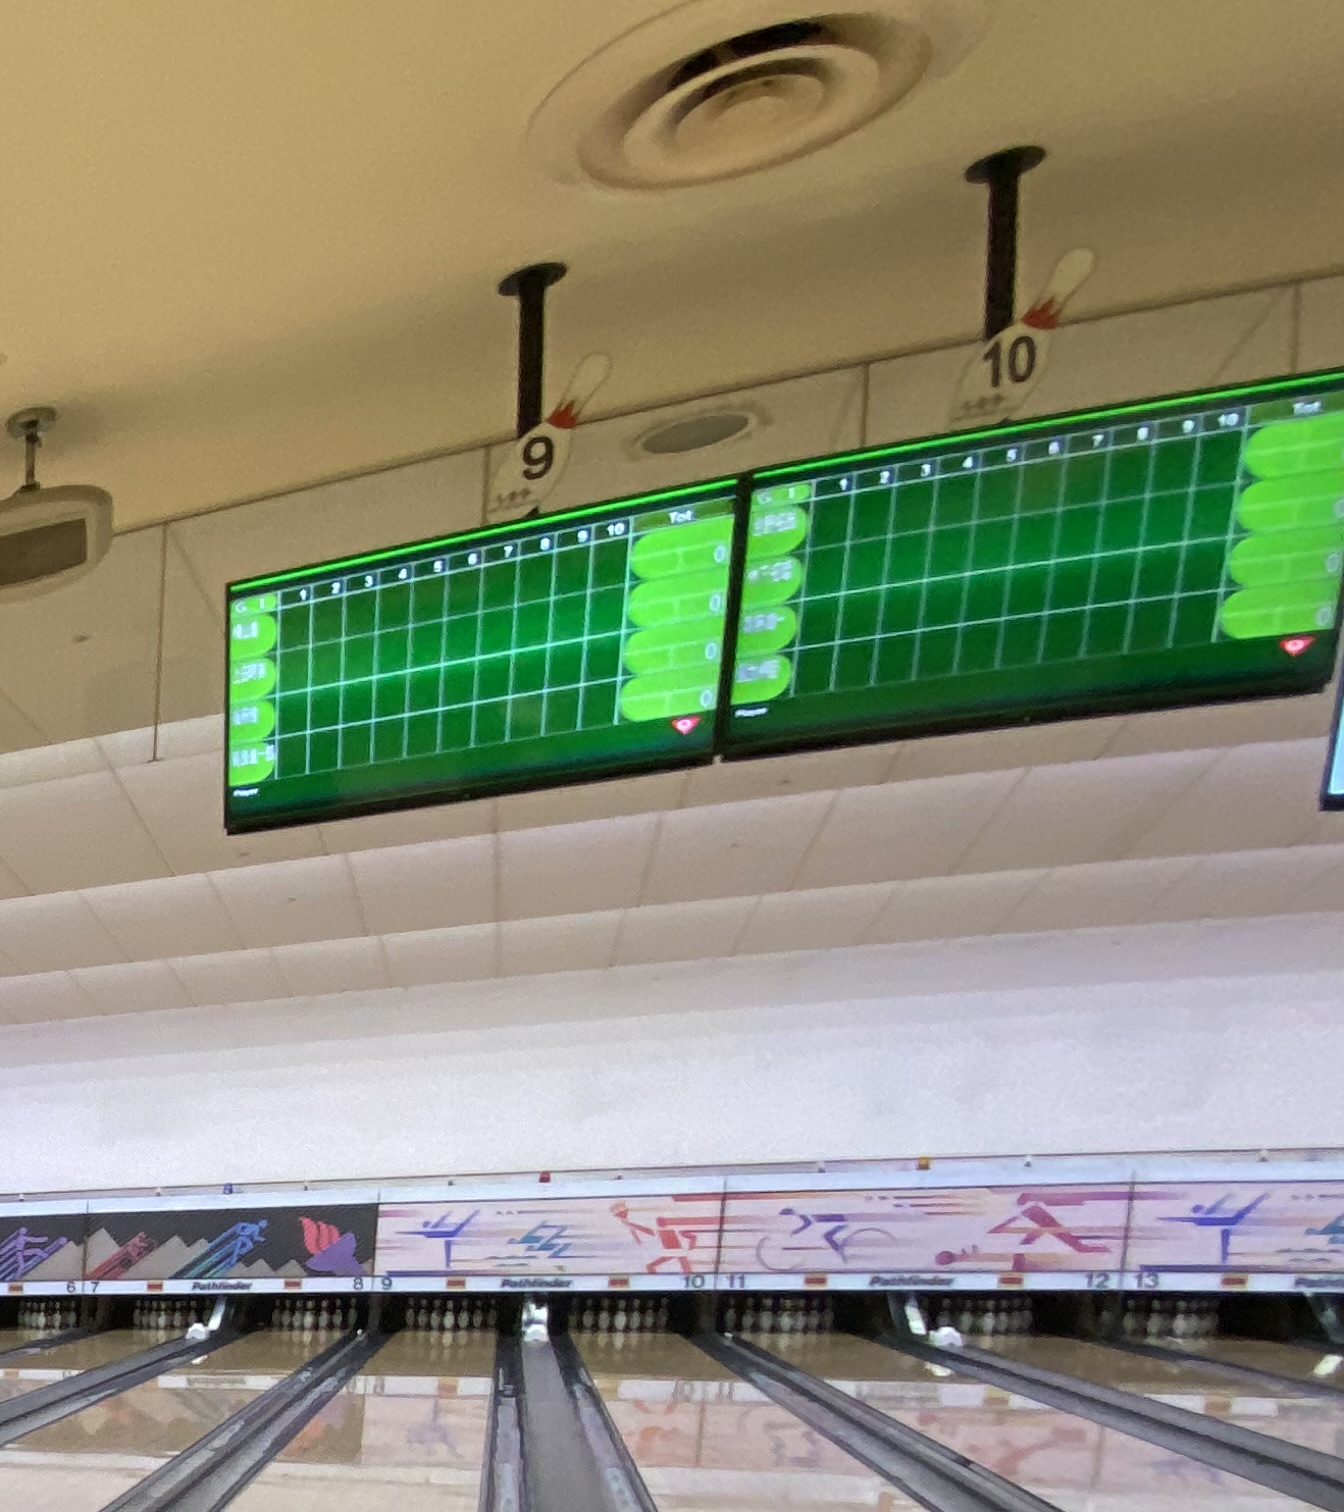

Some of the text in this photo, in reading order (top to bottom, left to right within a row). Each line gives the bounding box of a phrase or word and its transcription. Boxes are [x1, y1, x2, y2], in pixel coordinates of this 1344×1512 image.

[982, 335, 1037, 388] 10
[522, 436, 554, 480] 9
[364, 575, 374, 588] 3
[398, 568, 408, 580] 4
[503, 545, 513, 558] 7
[669, 510, 694, 524] Tot
[66, 1281, 76, 1293] 6
[90, 1281, 99, 1293] 7
[192, 1281, 253, 1291] Pathfinder
[353, 1277, 365, 1290] 8
[381, 1277, 393, 1290] 9
[500, 1277, 573, 1289] Pathfinder
[684, 1275, 706, 1289] 10
[727, 1275, 746, 1289] 11
[869, 1275, 955, 1288] Pathfinder
[1086, 1273, 1110, 1289] 12
[1136, 1273, 1160, 1289] 13
